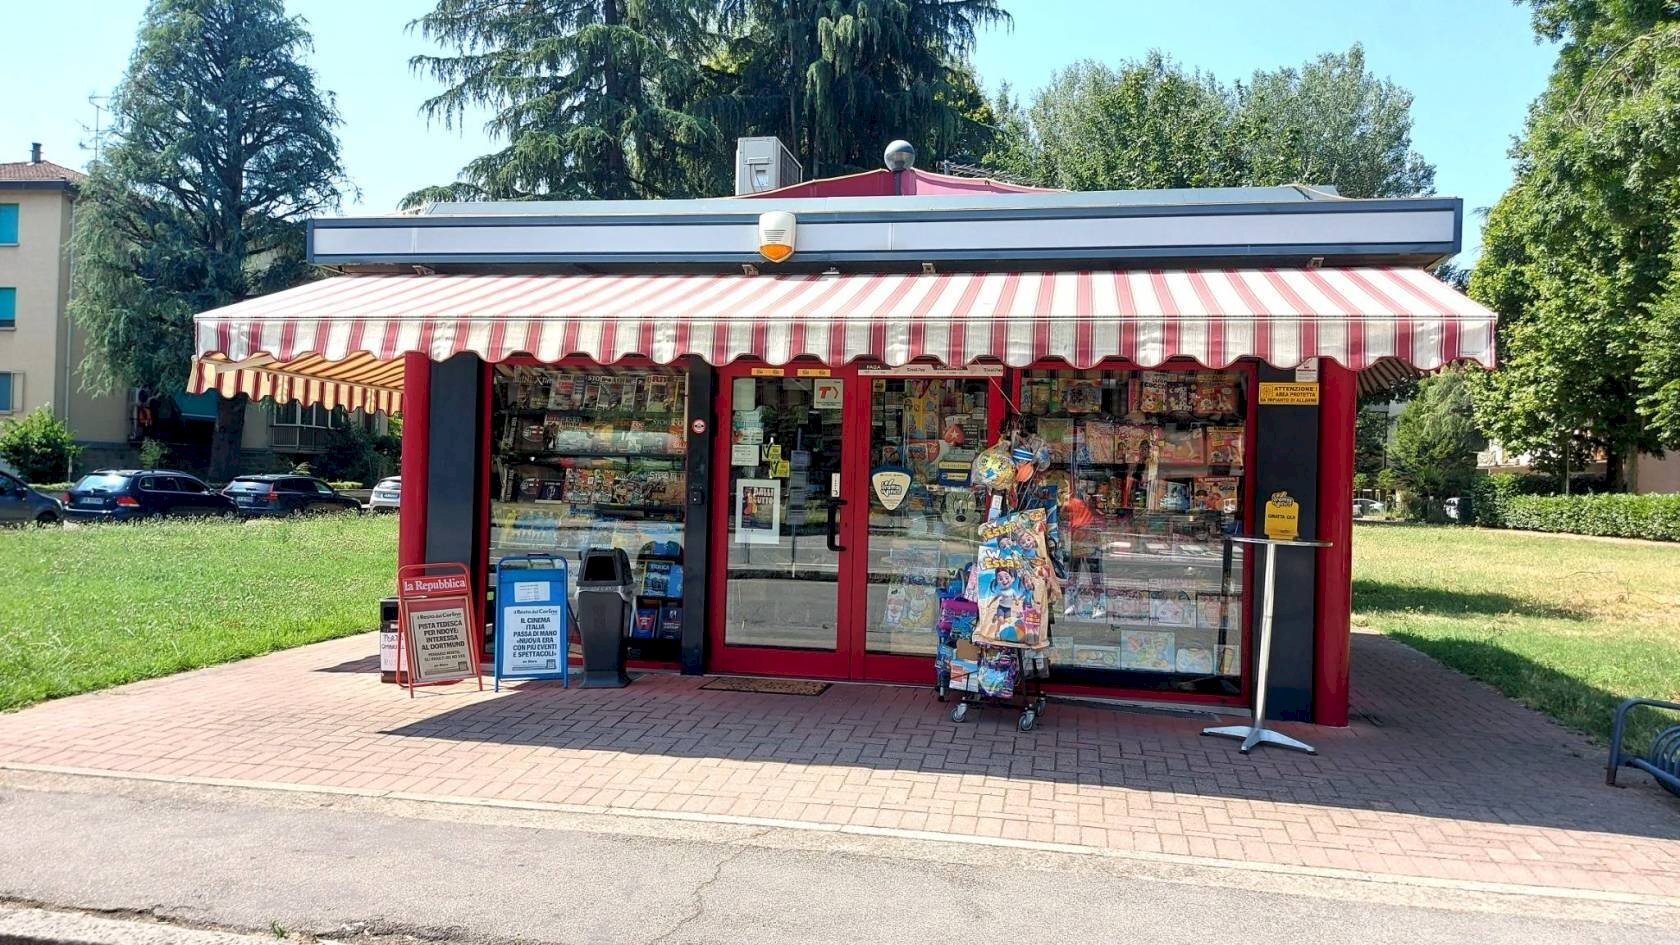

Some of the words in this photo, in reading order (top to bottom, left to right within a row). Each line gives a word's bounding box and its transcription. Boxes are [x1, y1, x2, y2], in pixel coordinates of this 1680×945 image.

[404, 581, 414, 592] la
[415, 578, 466, 592] Repubblica
[436, 620, 462, 628] TEDESCA
[430, 641, 465, 649] DORTMUND
